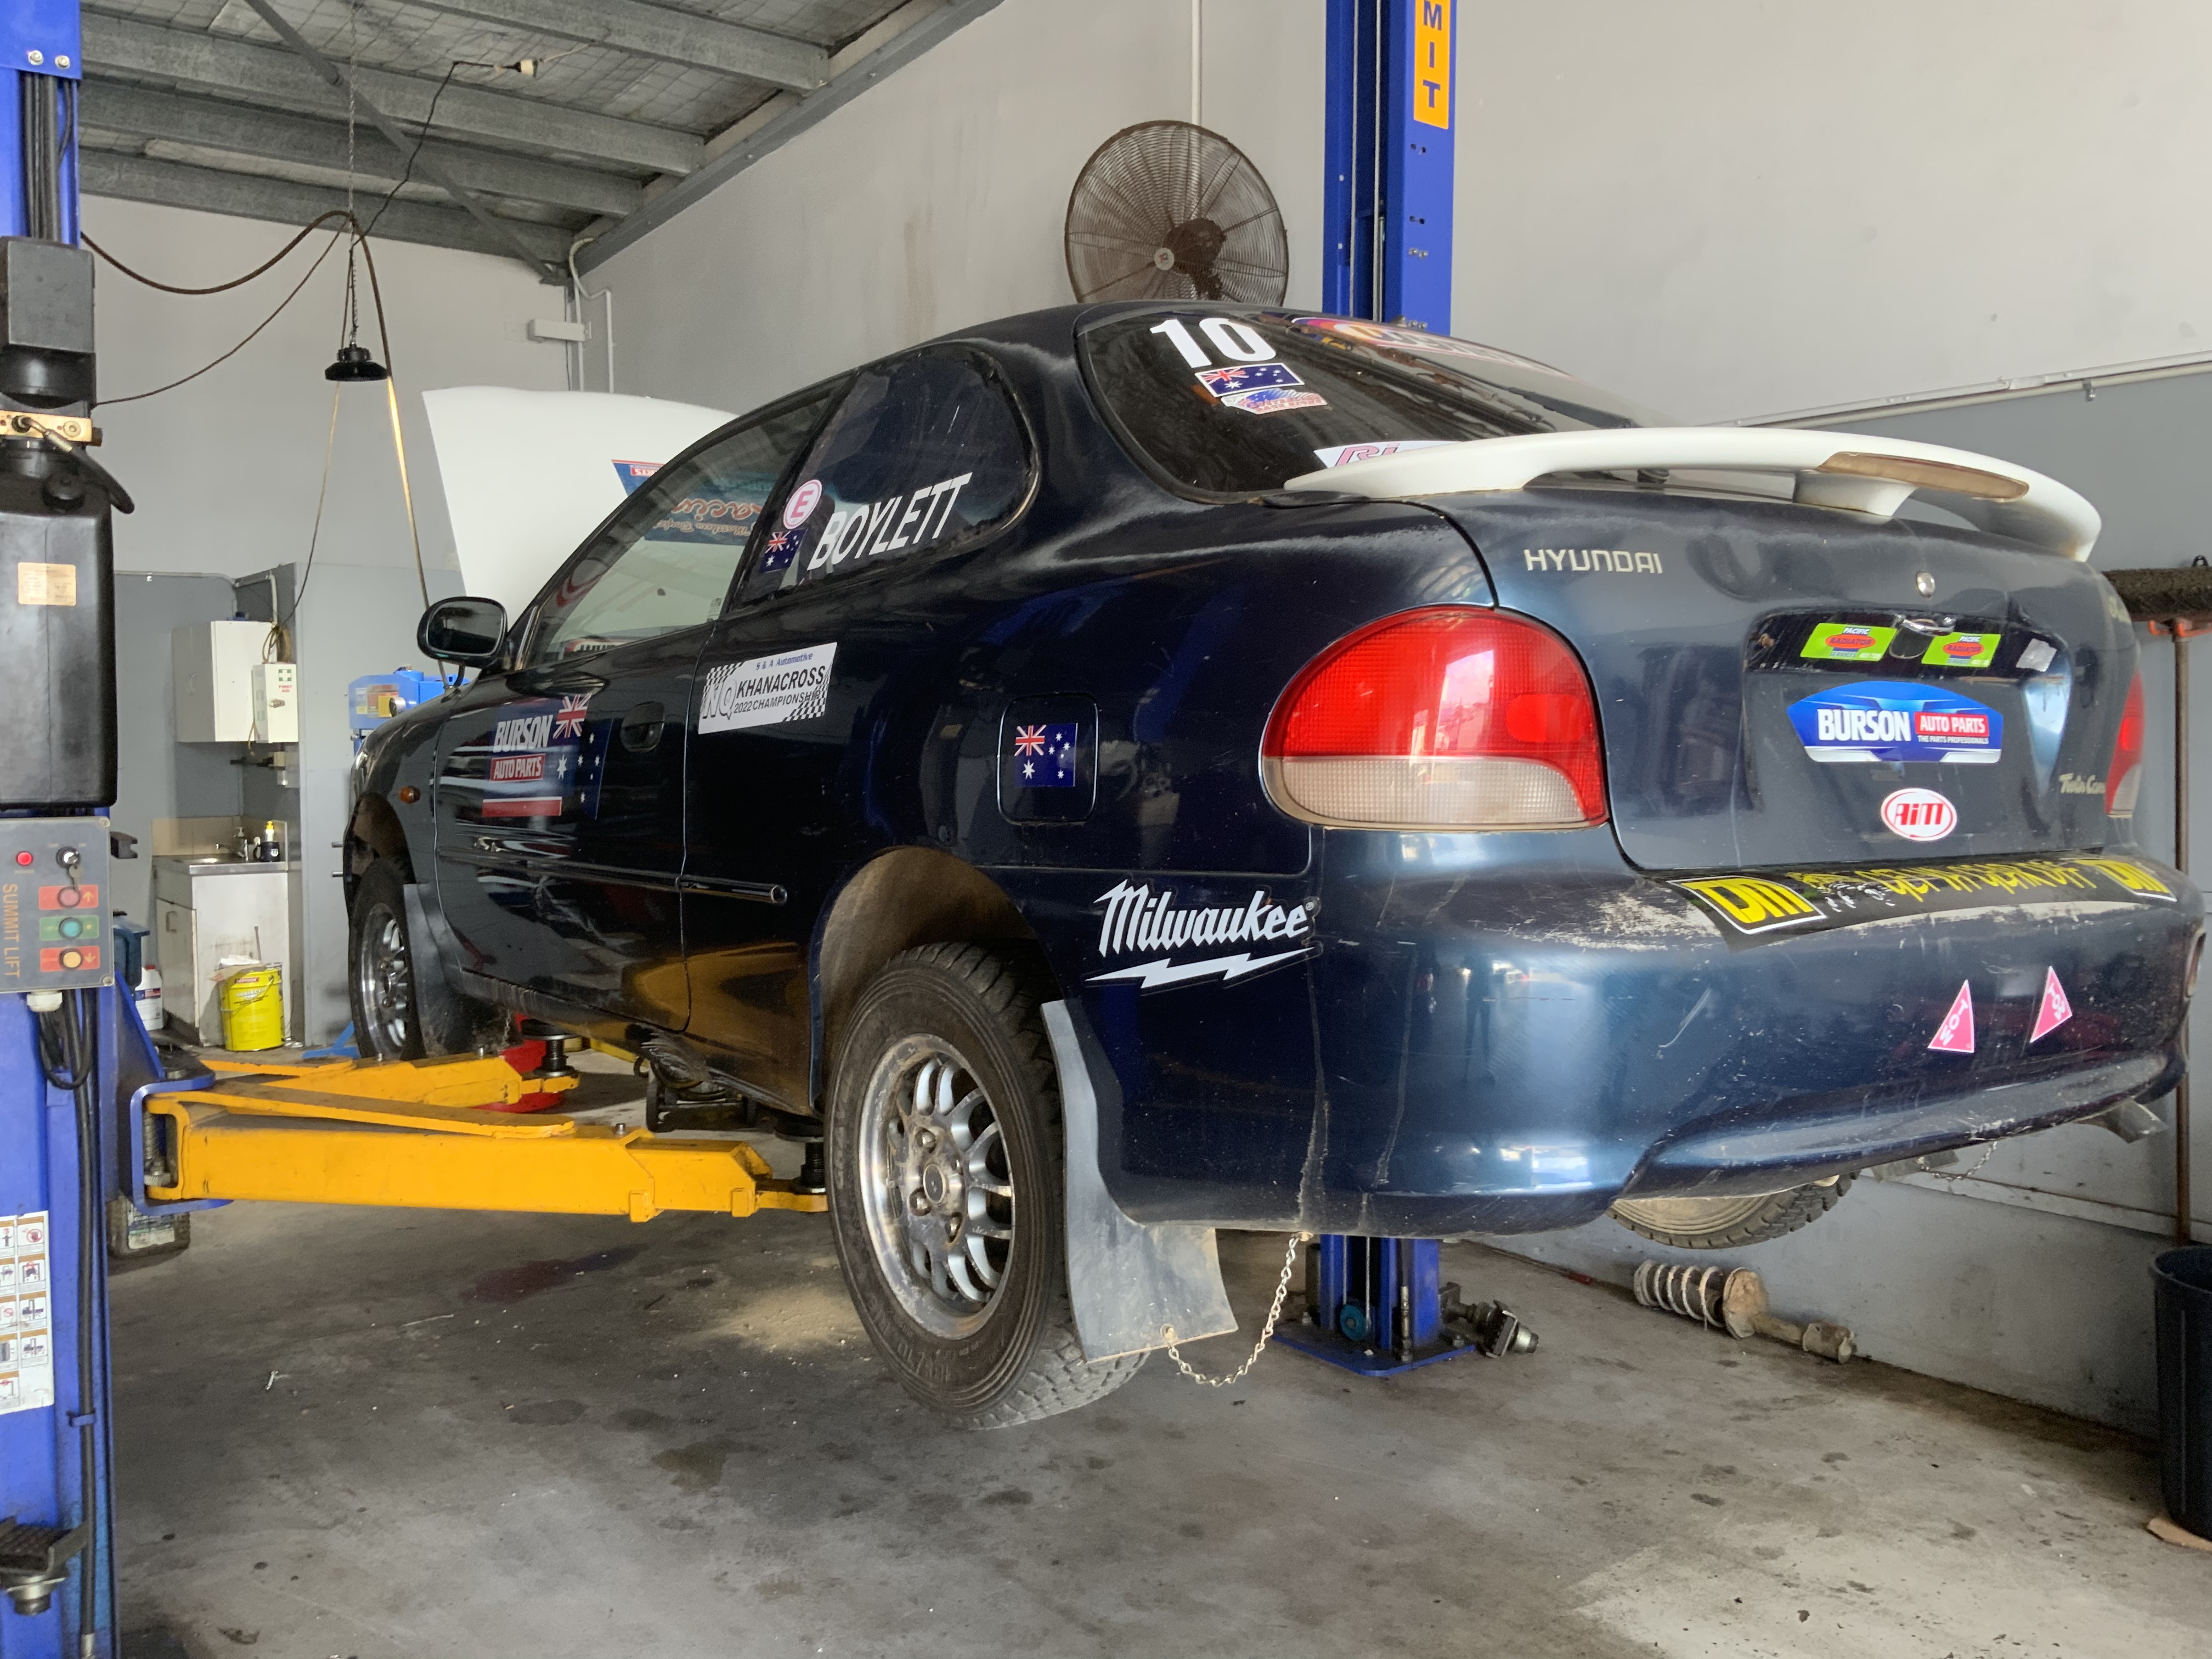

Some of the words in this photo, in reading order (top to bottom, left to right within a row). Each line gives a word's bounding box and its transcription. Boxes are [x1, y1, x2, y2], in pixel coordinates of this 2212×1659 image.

[1149, 317, 1277, 368] 10
[790, 490, 815, 518] E
[807, 472, 973, 571] BOYLETT
[1523, 549, 1663, 574] HYUNDAI
[776, 652, 814, 667] Automotive
[736, 665, 826, 698] KHANACROSS
[733, 702, 752, 714] 2022
[752, 690, 821, 711] CHAMPIONSHIP
[493, 715, 553, 753] BURSON
[1817, 709, 1911, 742] BURSON
[1920, 715, 1950, 732] AUTO
[1951, 716, 1986, 733] PARTS
[494, 759, 515, 779] AUTO
[515, 757, 542, 778] PARTS
[3, 883, 20, 943] SUMMIT
[1093, 879, 1309, 958] Milwaukee
[4, 947, 20, 978] LIFT
[2046, 982, 2066, 1021] TOW
[1939, 998, 1968, 1046] TOW
